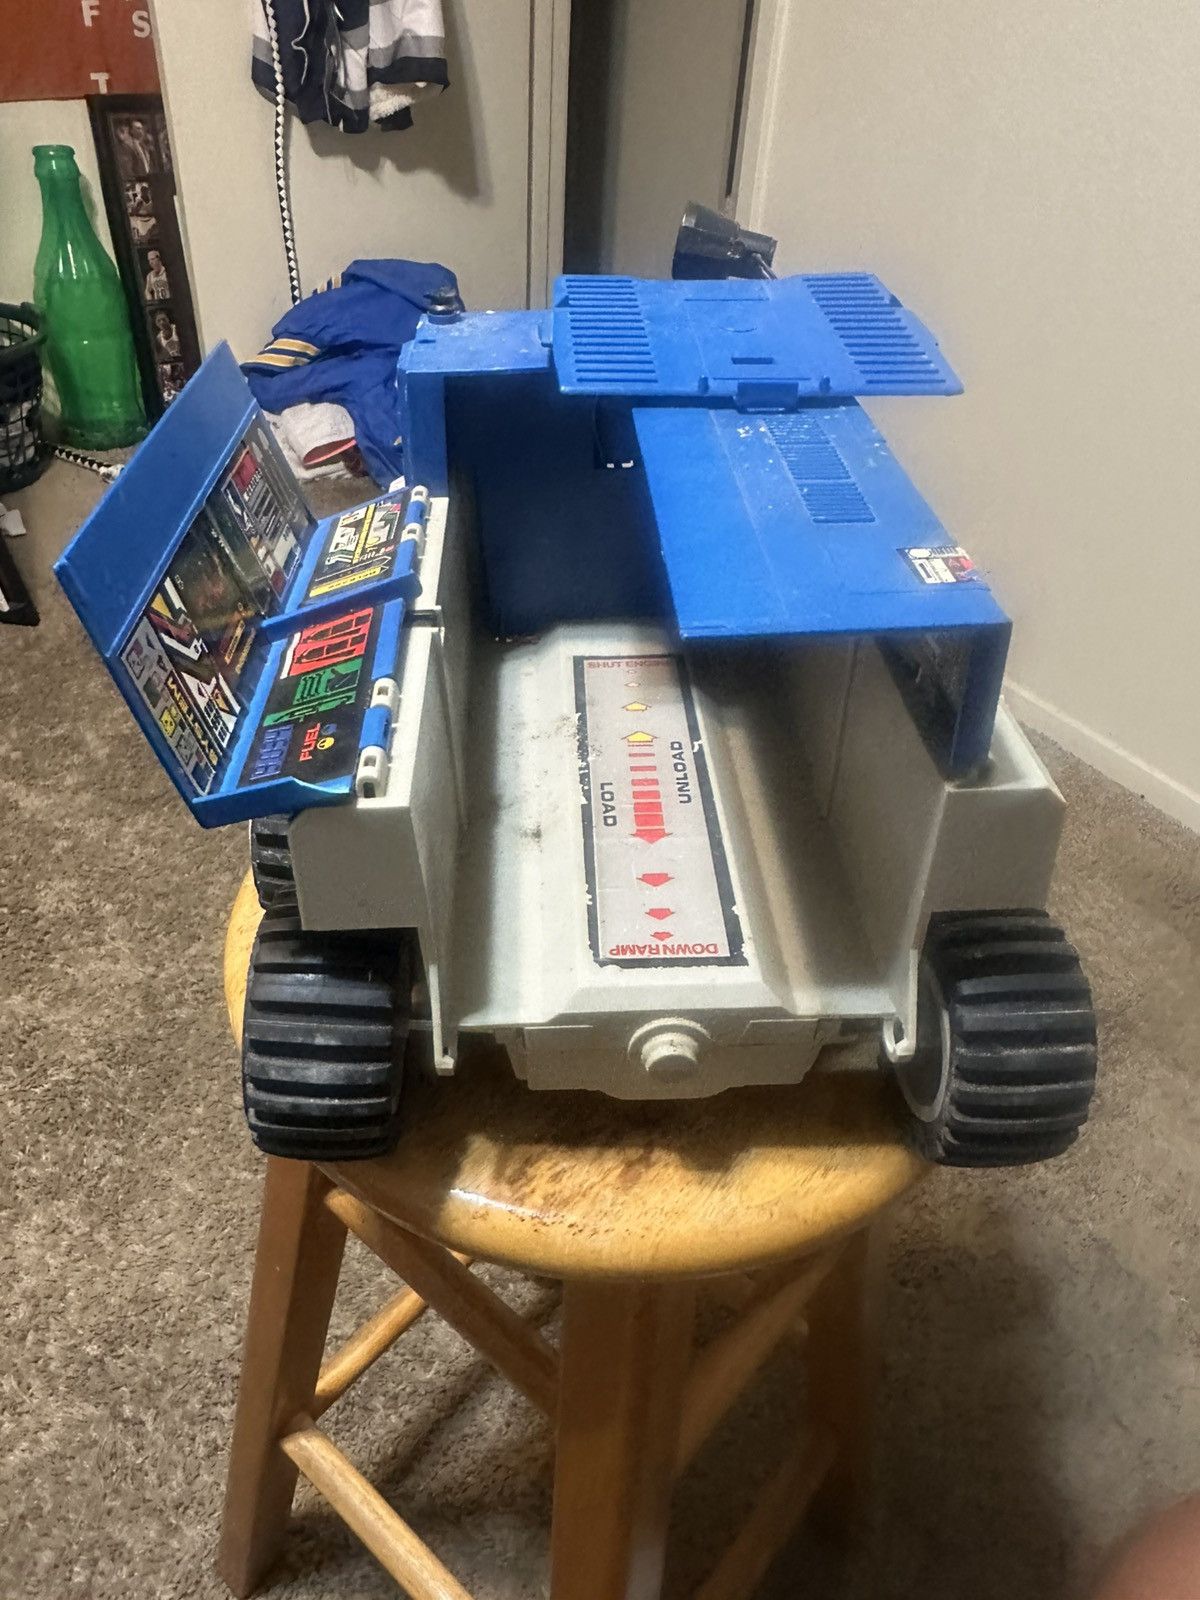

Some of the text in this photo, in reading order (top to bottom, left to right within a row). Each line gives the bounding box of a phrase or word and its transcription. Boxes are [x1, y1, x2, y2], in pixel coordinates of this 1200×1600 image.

[300, 723, 321, 761] FUEL
[670, 741, 692, 804] UNLOAD
[600, 782, 617, 827] LOAD
[609, 943, 719, 956] DOWN RAMP
